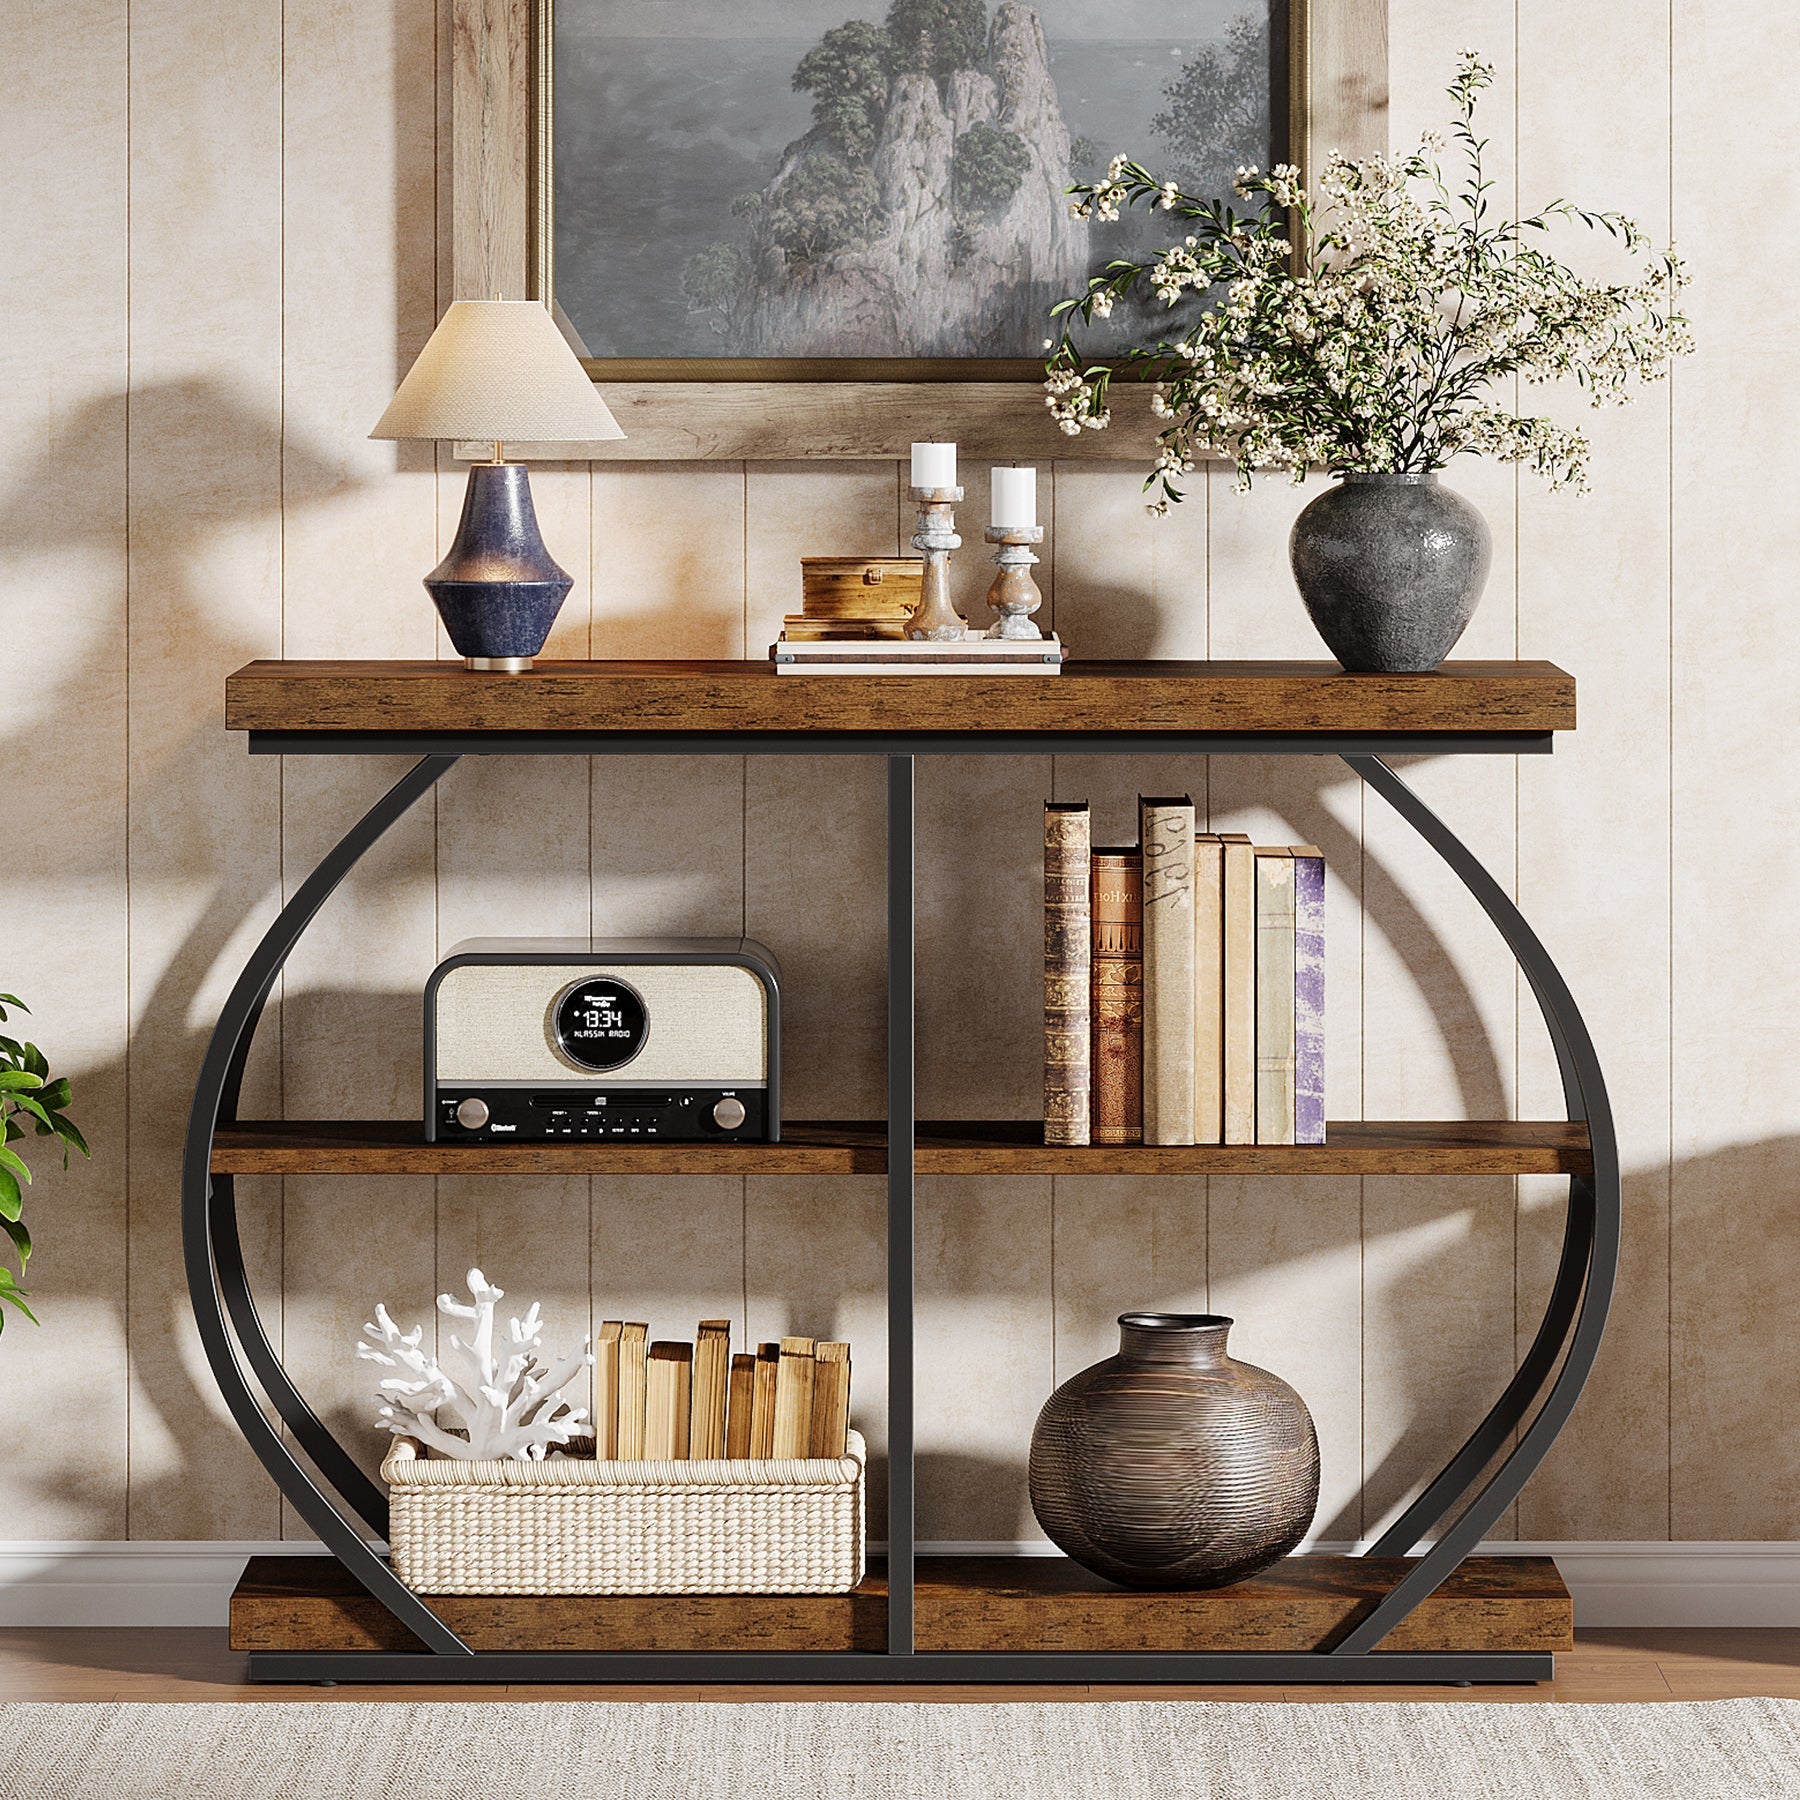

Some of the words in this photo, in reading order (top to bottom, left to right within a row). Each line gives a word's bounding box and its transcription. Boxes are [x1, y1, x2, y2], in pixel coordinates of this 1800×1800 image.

[582, 1010, 622, 1028] 13:34
[574, 1030, 605, 1038] KLASSIK
[608, 1030, 631, 1038] RADIO
